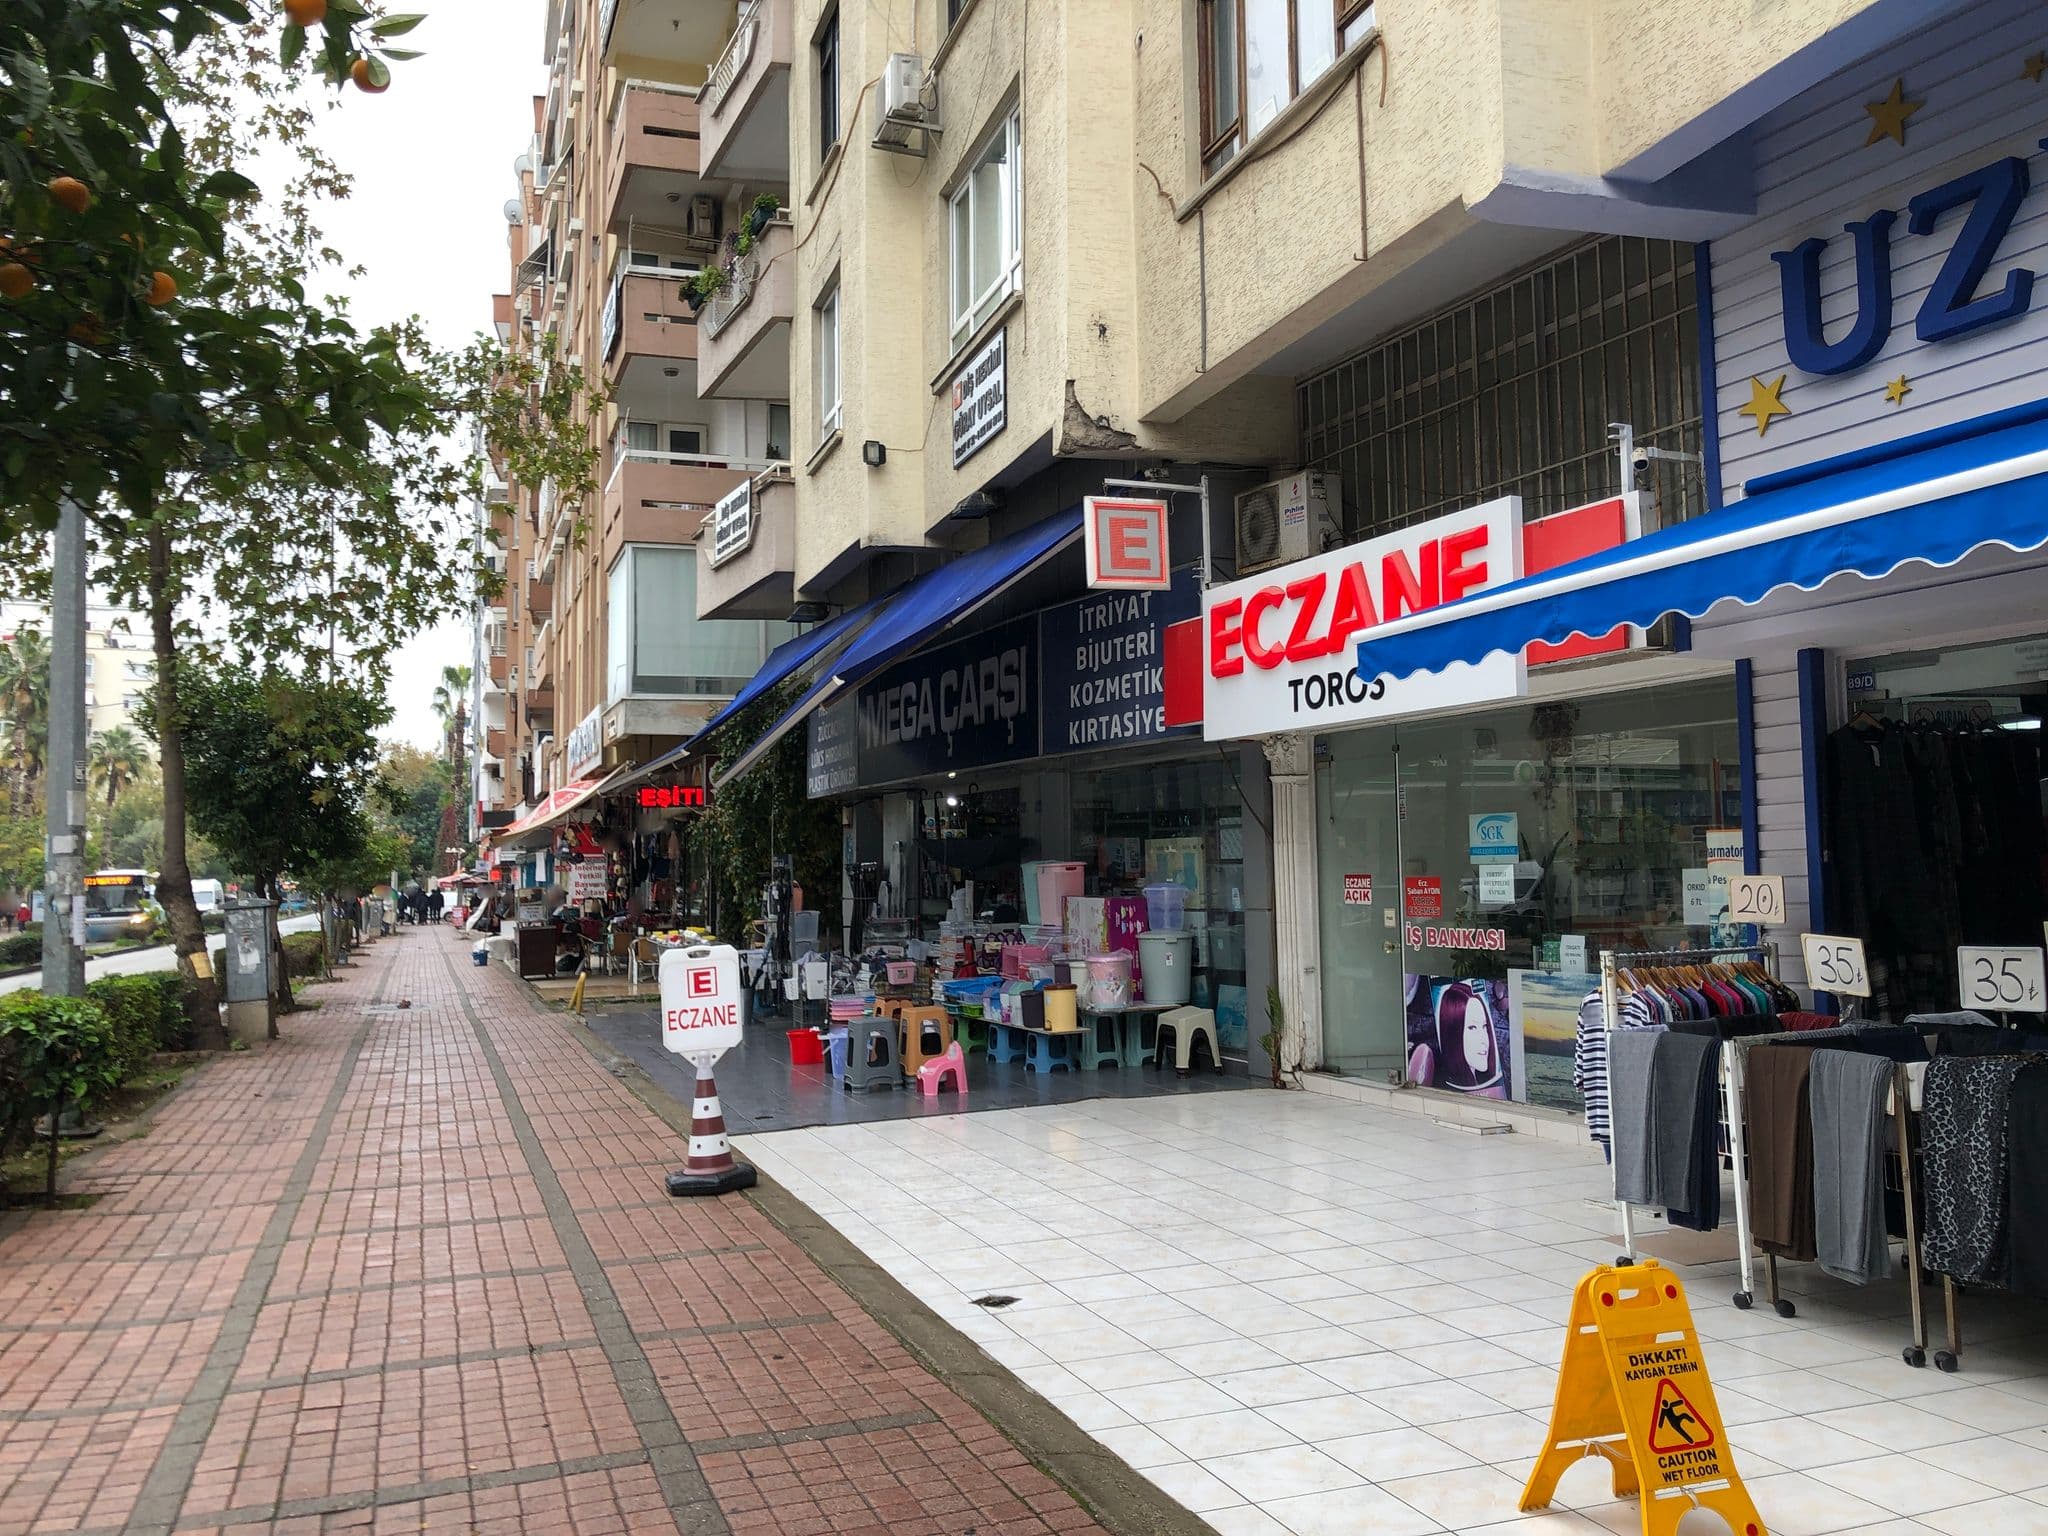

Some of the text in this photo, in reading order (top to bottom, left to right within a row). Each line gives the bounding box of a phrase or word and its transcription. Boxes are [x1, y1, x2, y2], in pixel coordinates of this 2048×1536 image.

[1771, 138, 2048, 376] UZ
[1108, 516, 1152, 571] E
[1079, 590, 1152, 635] İTRİYAT
[1211, 523, 1489, 680] ECZANE
[1076, 622, 1156, 673] BİJUTERİ
[1070, 663, 1165, 709] KOZMETİK
[1288, 667, 1386, 713] TOROS
[1848, 675, 1874, 689] 89/D
[859, 645, 1028, 758] MEGA ÇARŞI
[1069, 704, 1166, 745] KIRTASİYE
[1480, 825, 1505, 841] SGK
[1345, 878, 1371, 889] ECZANE
[1345, 890, 1371, 903] AÇIK
[1405, 921, 1506, 951] İŞ BANKASI
[693, 971, 712, 994] E
[667, 1004, 738, 1031] ECZANE
[1625, 1366, 1666, 1381] KAYGAN
[1658, 1448, 1718, 1469] CAUTION
[1662, 1464, 1720, 1483] WET FLOOR
